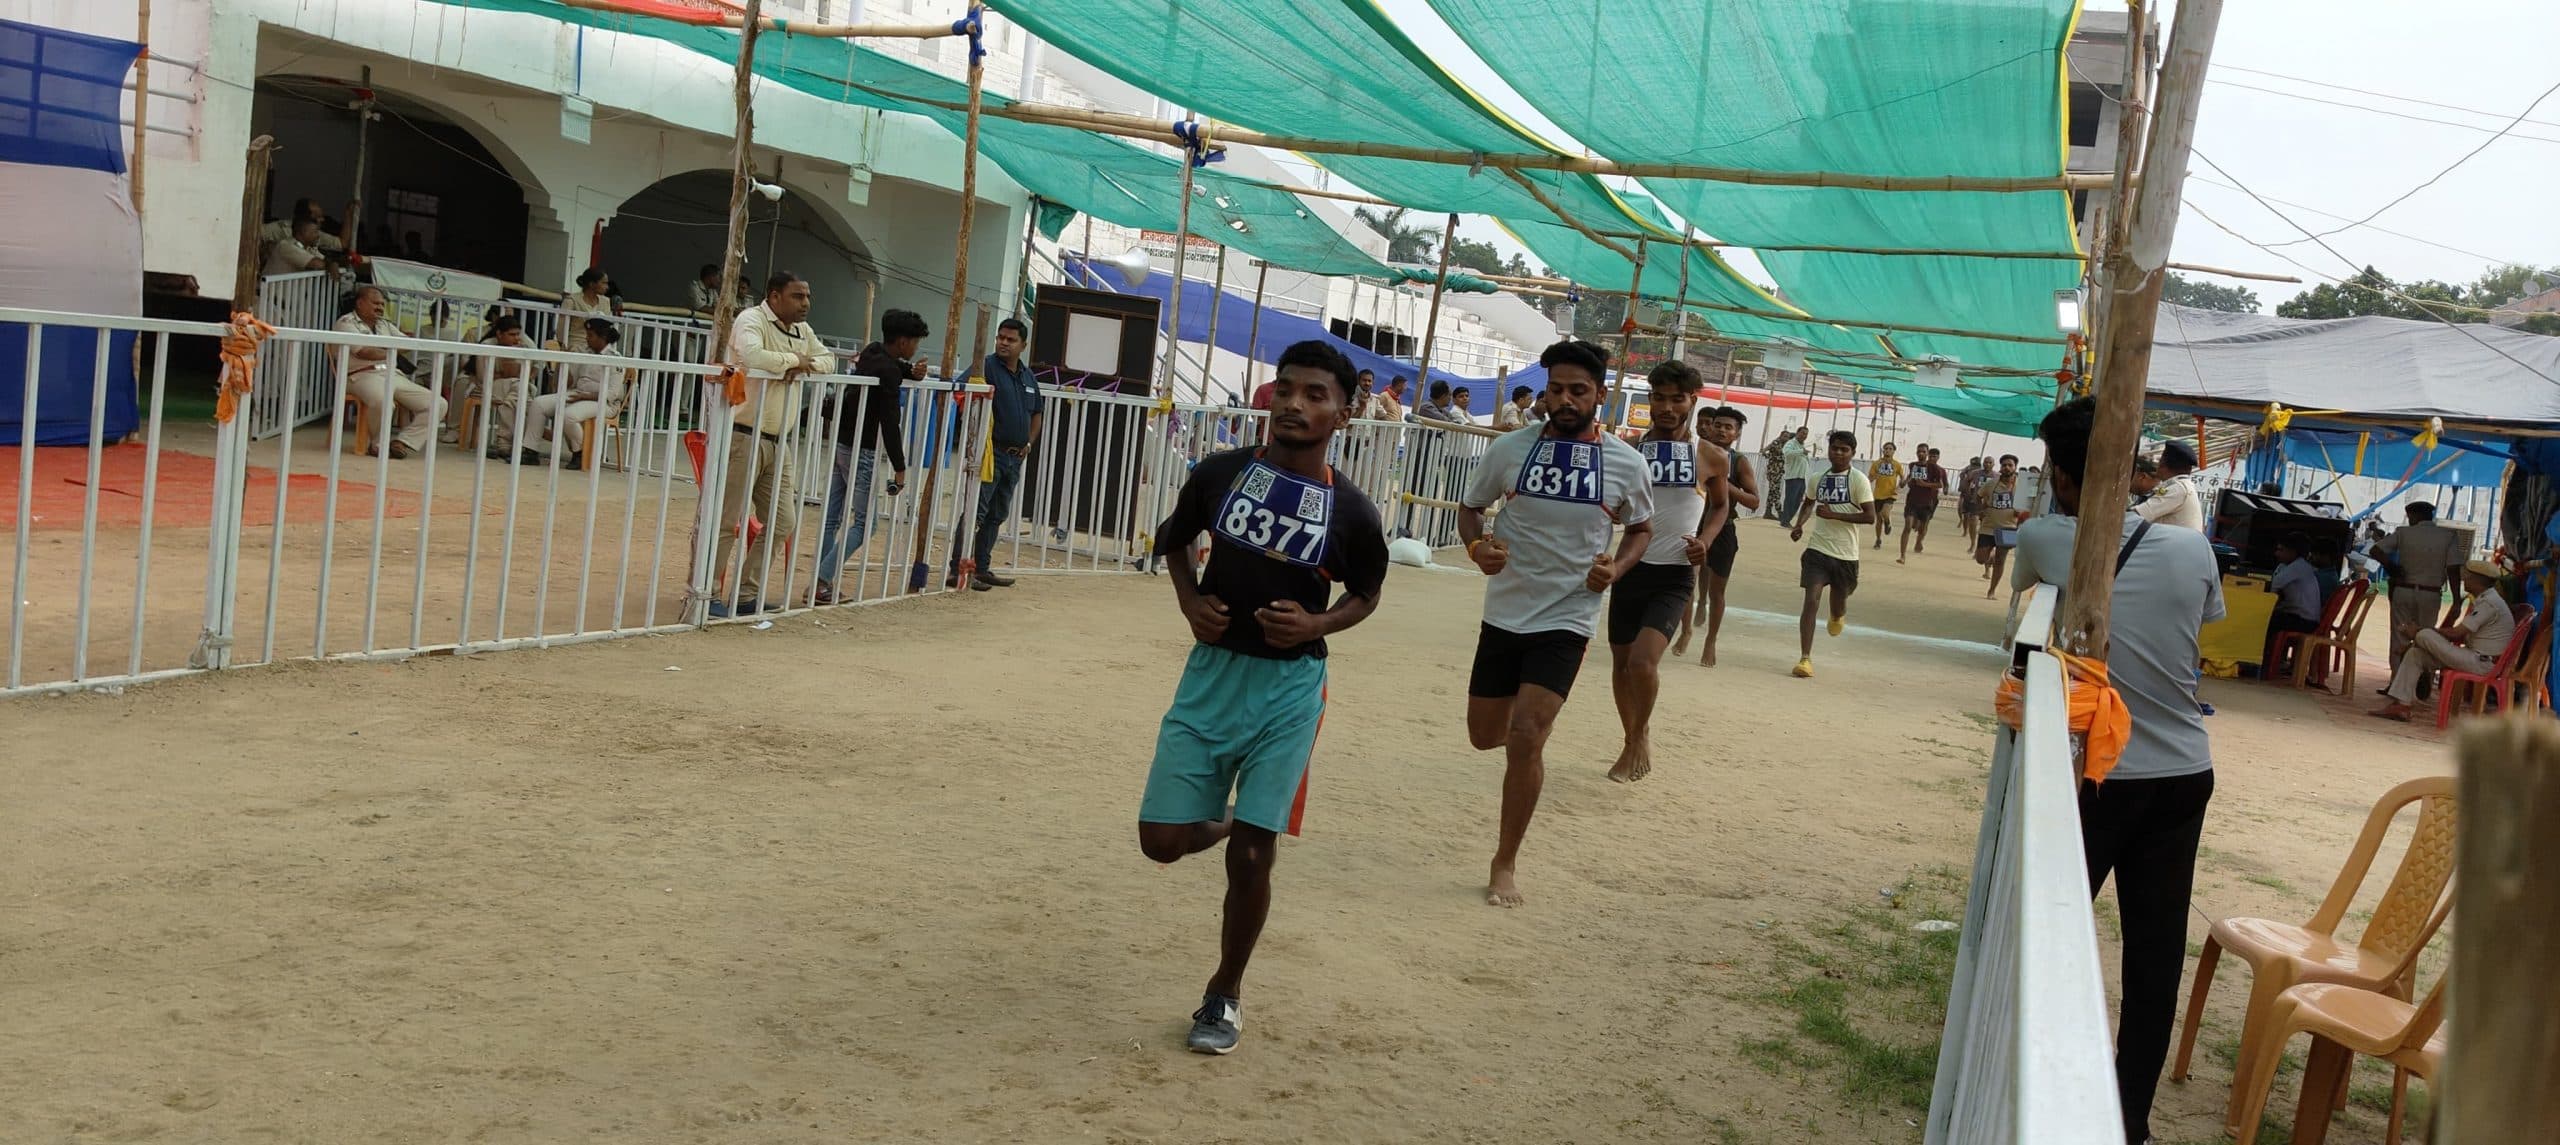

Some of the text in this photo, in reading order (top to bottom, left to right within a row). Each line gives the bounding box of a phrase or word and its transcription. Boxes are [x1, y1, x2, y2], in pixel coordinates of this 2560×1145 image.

[1526, 465, 1596, 498] 8311
[1650, 460, 1693, 482] 015
[1818, 487, 1847, 502] 8447
[1225, 498, 1325, 561] 8377
